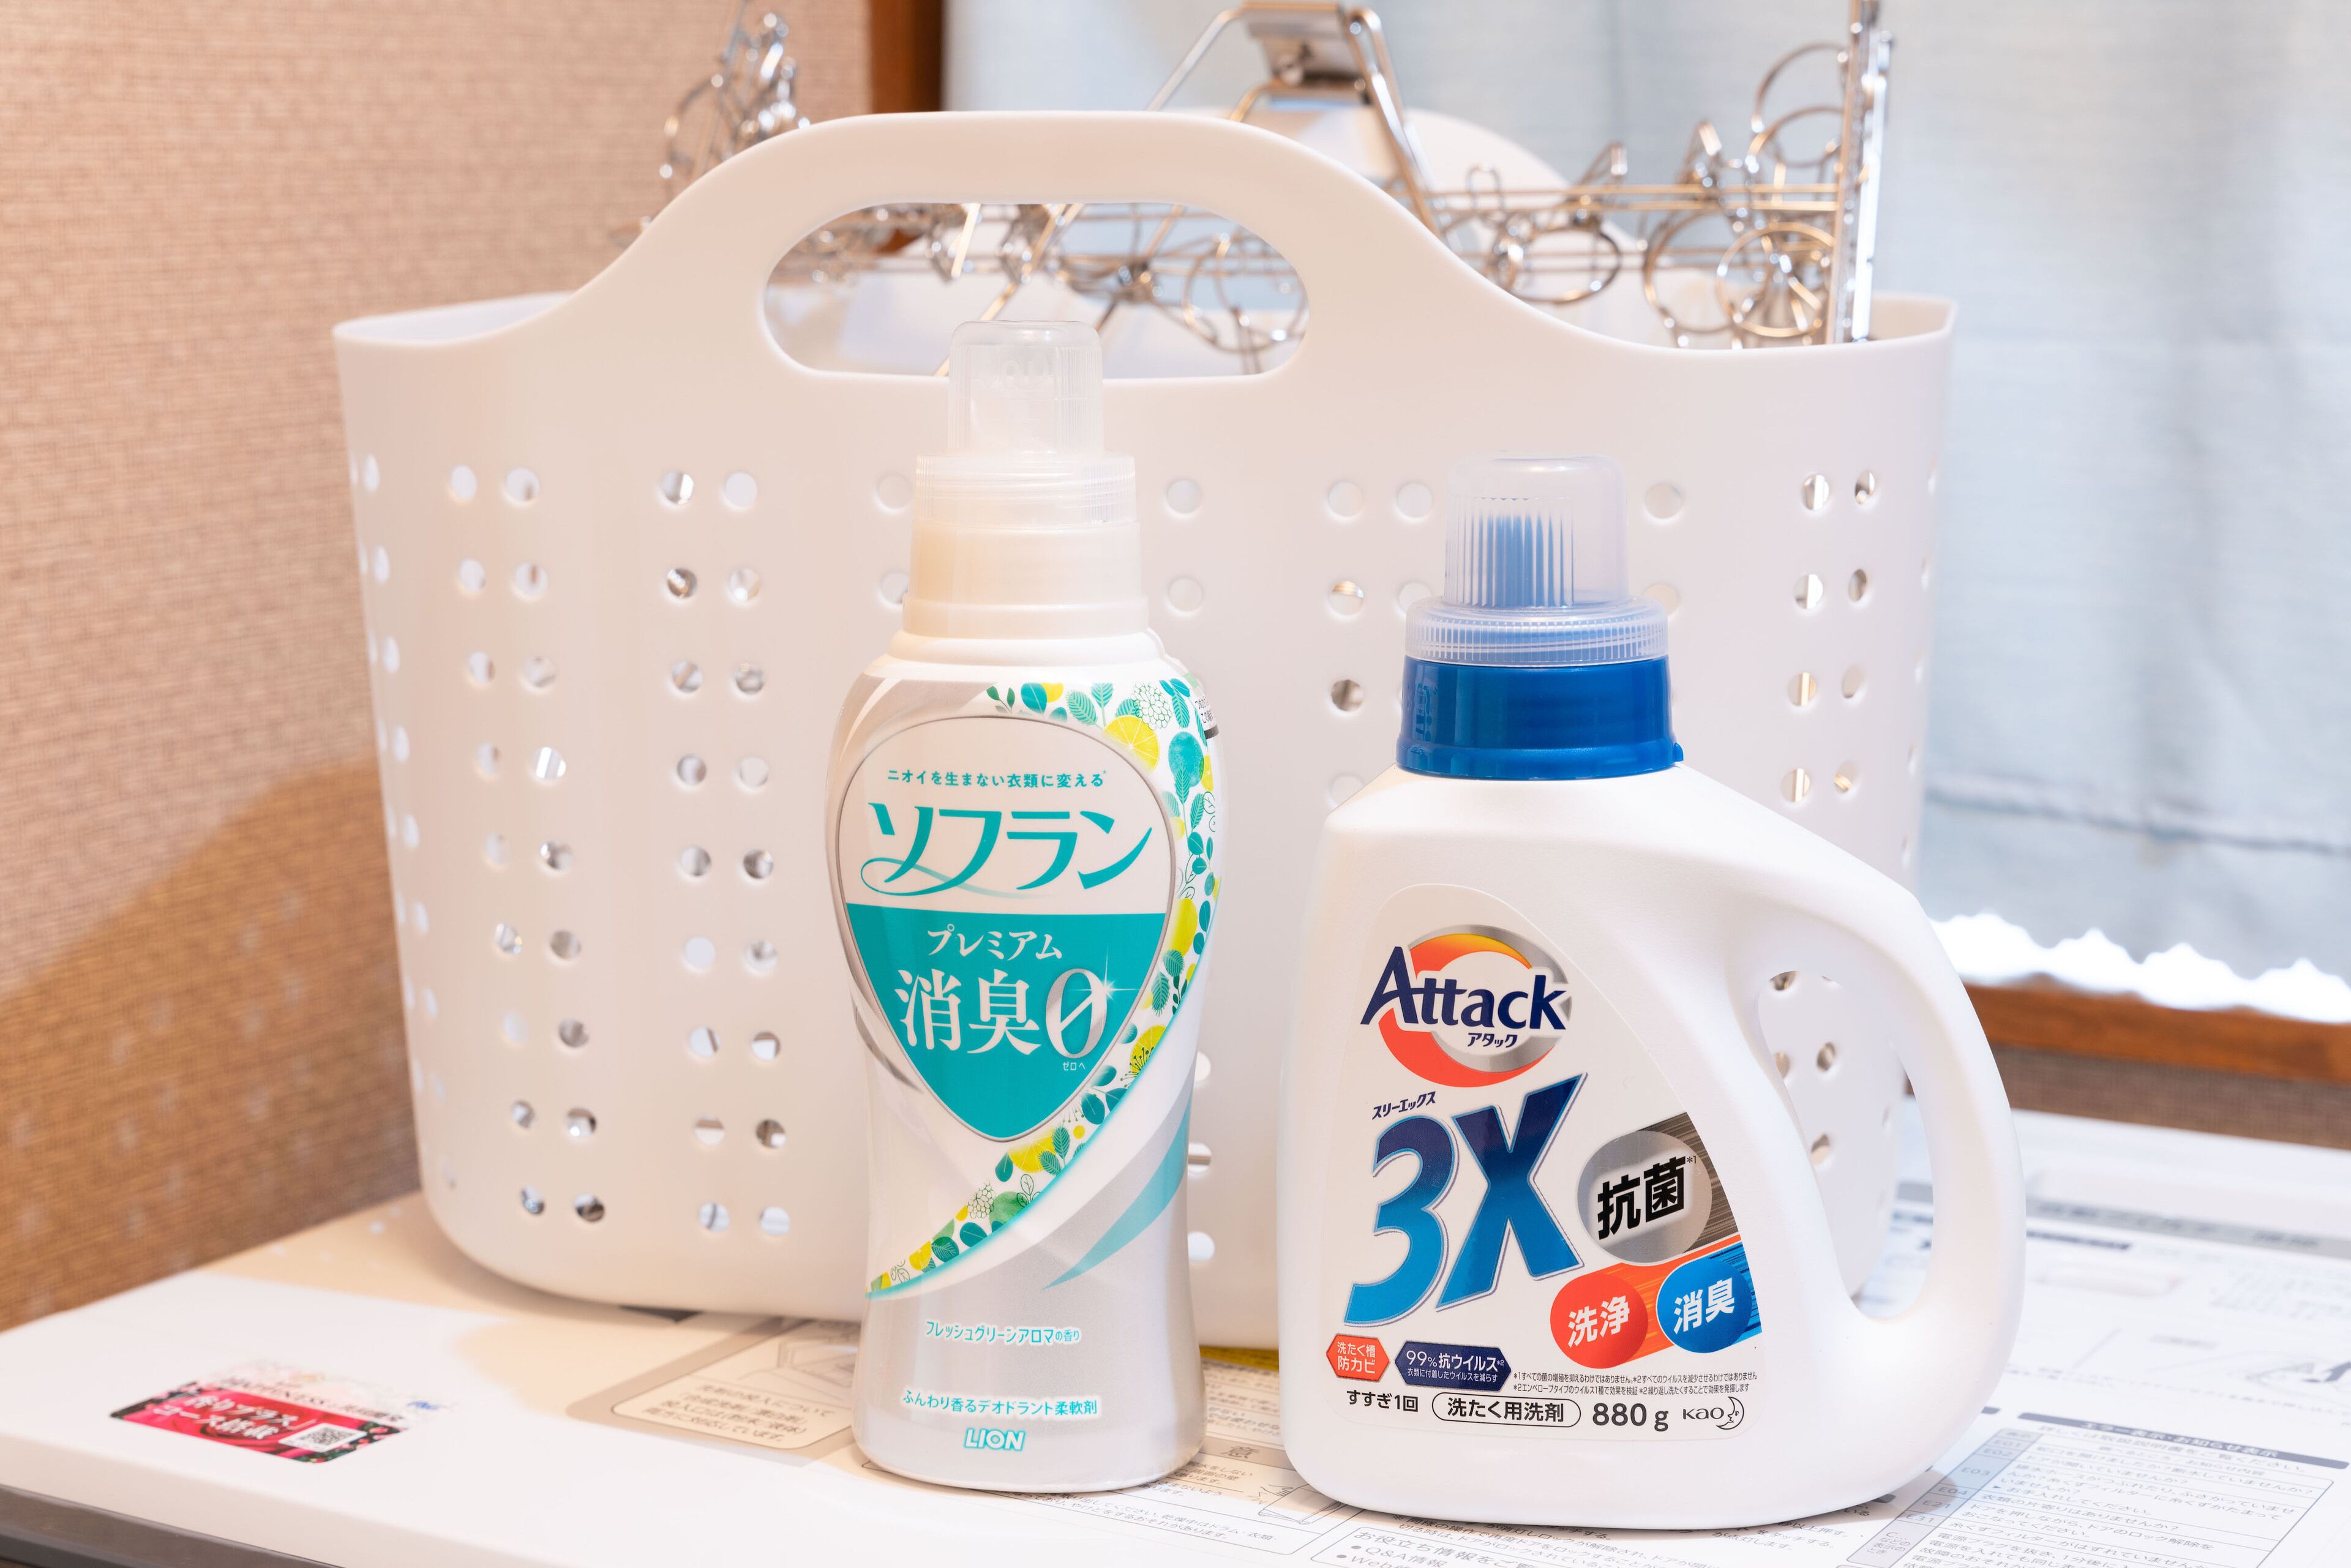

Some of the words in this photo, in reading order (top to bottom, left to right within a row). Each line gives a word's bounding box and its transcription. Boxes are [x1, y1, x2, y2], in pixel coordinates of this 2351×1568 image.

[860, 801, 1153, 898] ソフラン
[927, 923, 1062, 962] プレミアム
[1360, 946, 1567, 1030] Attack
[1467, 1032, 1518, 1048] アタック
[1062, 1061, 1086, 1071] ゼロへ
[1371, 1091, 1436, 1120] スリーエックス
[1343, 1071, 1589, 1328] 3X
[1672, 1278, 1736, 1337] 消臭
[925, 1320, 1081, 1345] フレッシュグリーンアロマの香り
[1567, 1294, 1631, 1348] 洗浄
[1337, 1341, 1376, 1358] 洗たく槽
[1338, 1356, 1376, 1375] 防カビ
[1407, 1368, 1499, 1383] 衣類に付着したウイルスを減らす
[902, 1389, 1098, 1416] ふんわり香るデオドラント柔軟剤
[1347, 1389, 1419, 1412] すすぎ1回
[1447, 1396, 1564, 1423] 洗たく用洗剤
[964, 1428, 1026, 1452] LION
[1984, 1448, 2013, 1457] E02
[1962, 1466, 1990, 1476] E03
[1938, 1486, 1968, 1496] E04
[1921, 1499, 1951, 1509] E21
[1905, 1514, 1934, 1523] E31
[1365, 1547, 1448, 1568] Q&A情報
